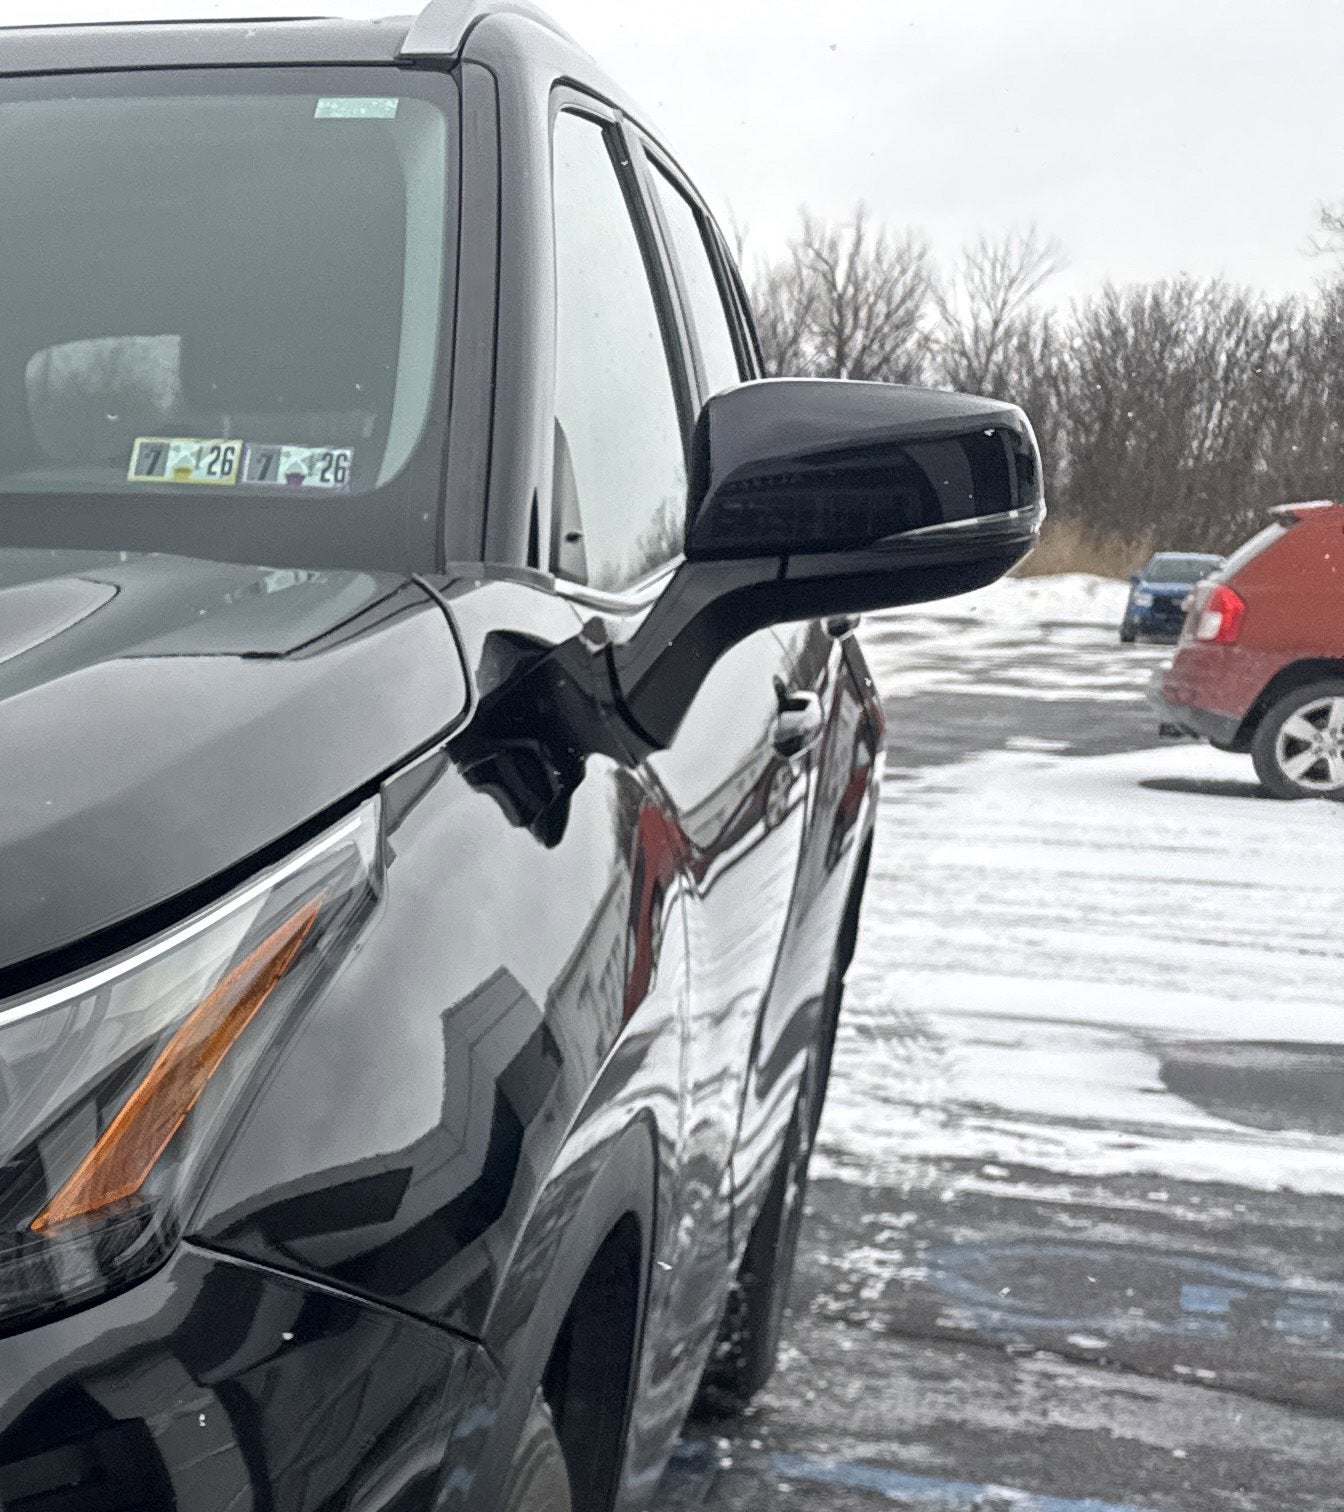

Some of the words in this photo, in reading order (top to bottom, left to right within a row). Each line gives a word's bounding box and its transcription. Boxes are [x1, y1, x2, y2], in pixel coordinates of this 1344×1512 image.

[143, 449, 162, 476] 7
[206, 445, 235, 476] 26
[256, 454, 274, 481] 7
[320, 452, 348, 483] 26
